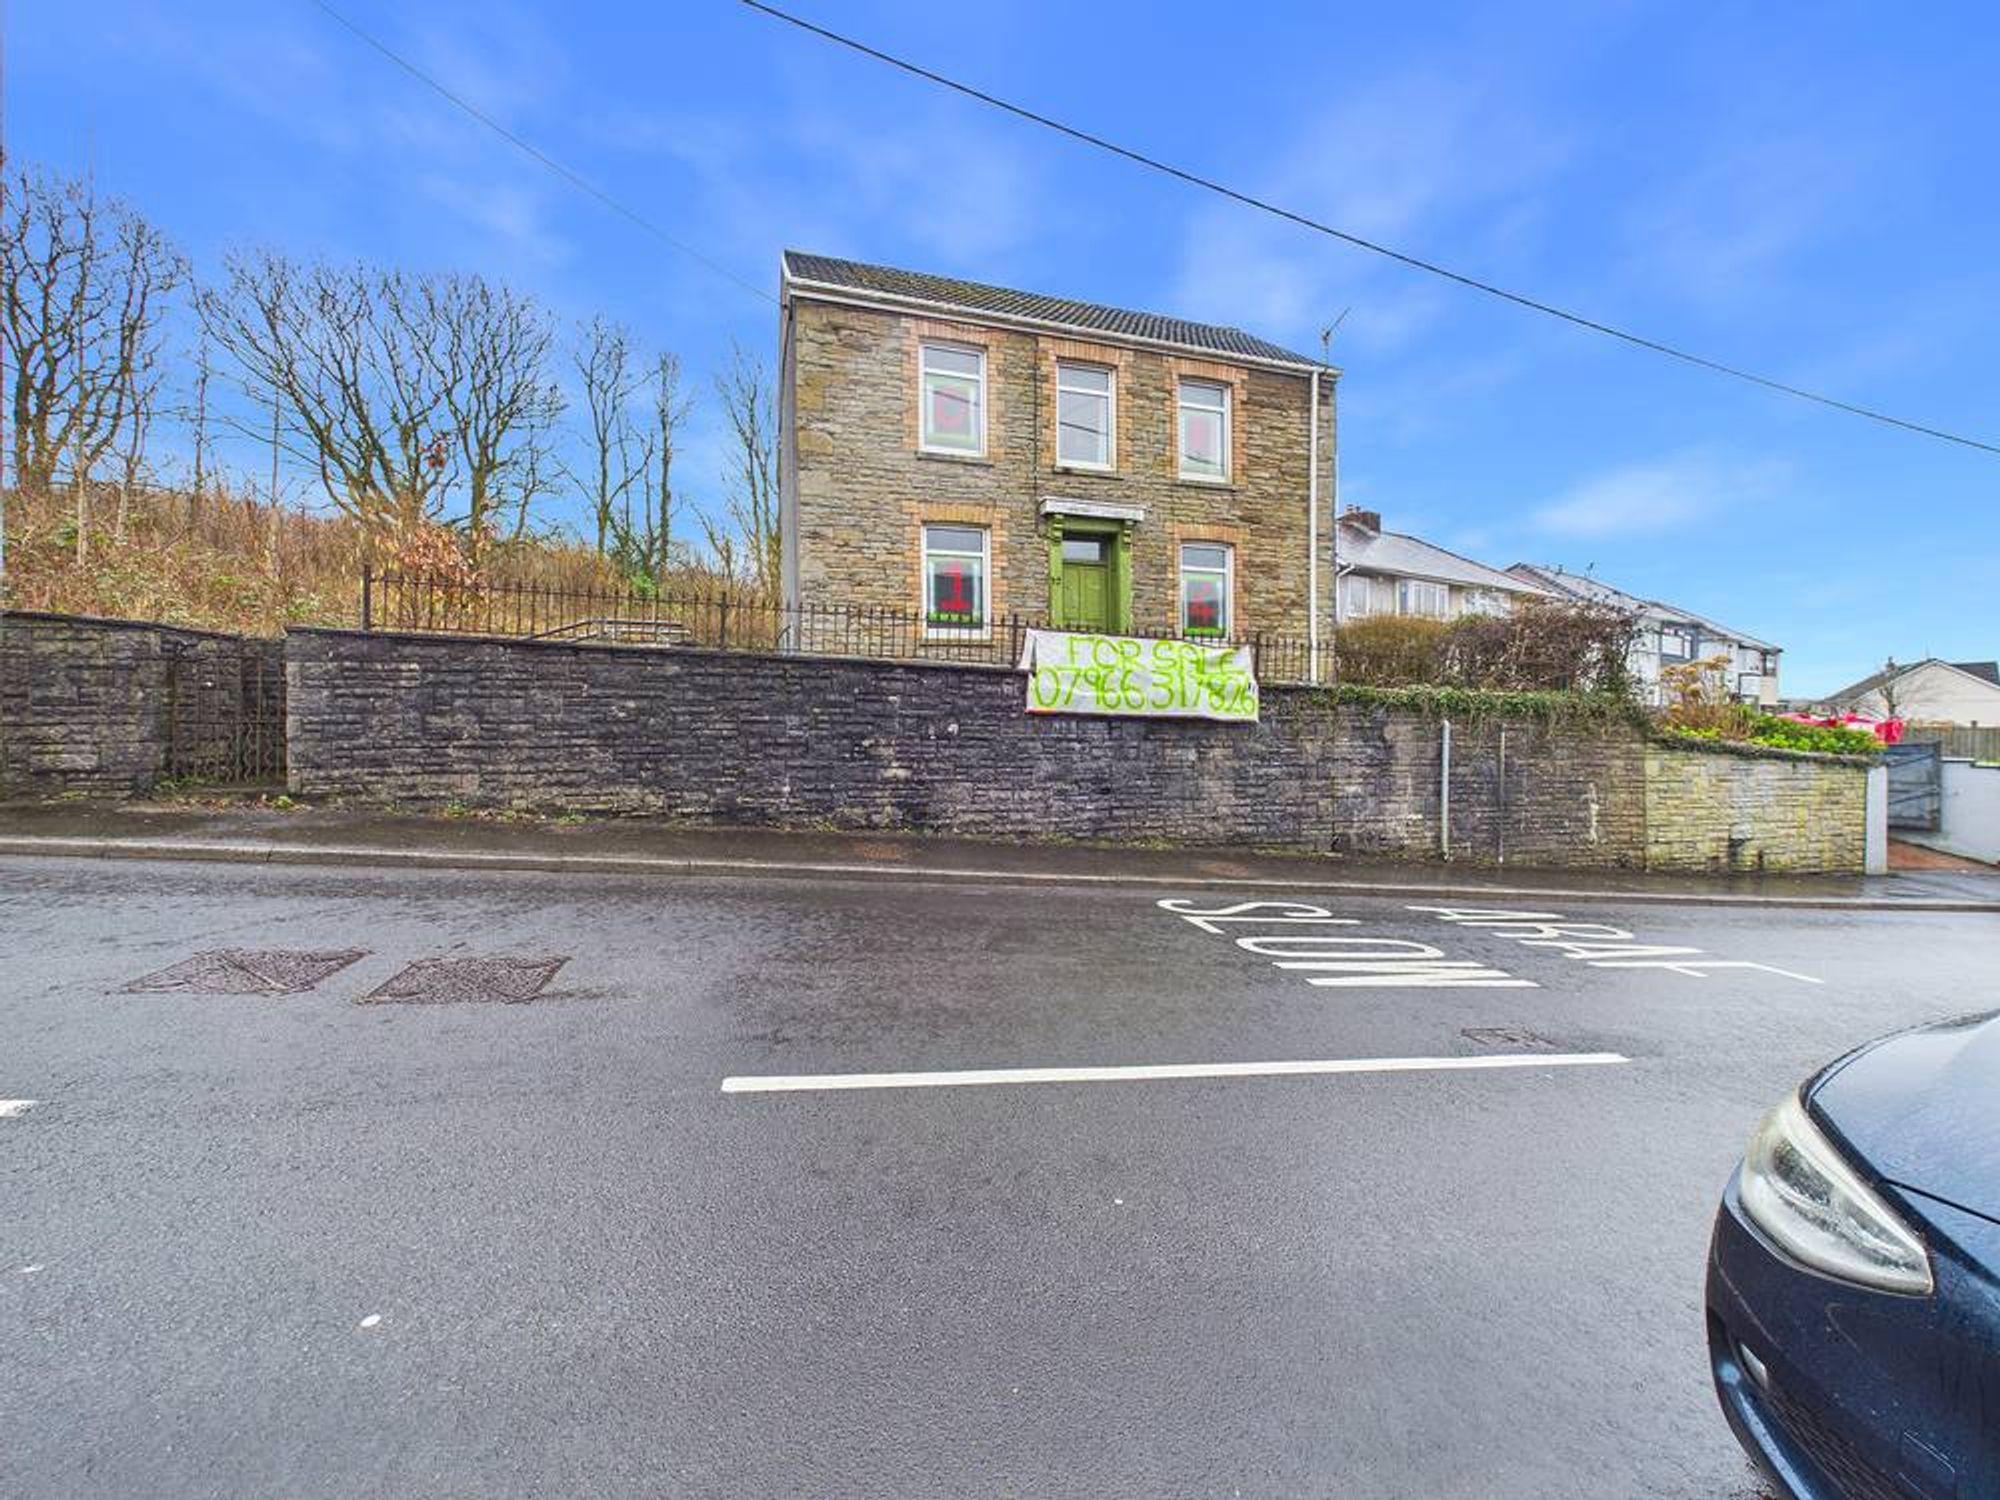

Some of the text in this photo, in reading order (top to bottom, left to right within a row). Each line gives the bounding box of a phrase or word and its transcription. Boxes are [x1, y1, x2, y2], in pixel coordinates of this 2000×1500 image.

[1066, 634, 1244, 674] FOR SALE
[1156, 898, 1541, 988] SLOW
[1405, 905, 1824, 984] ARAF
